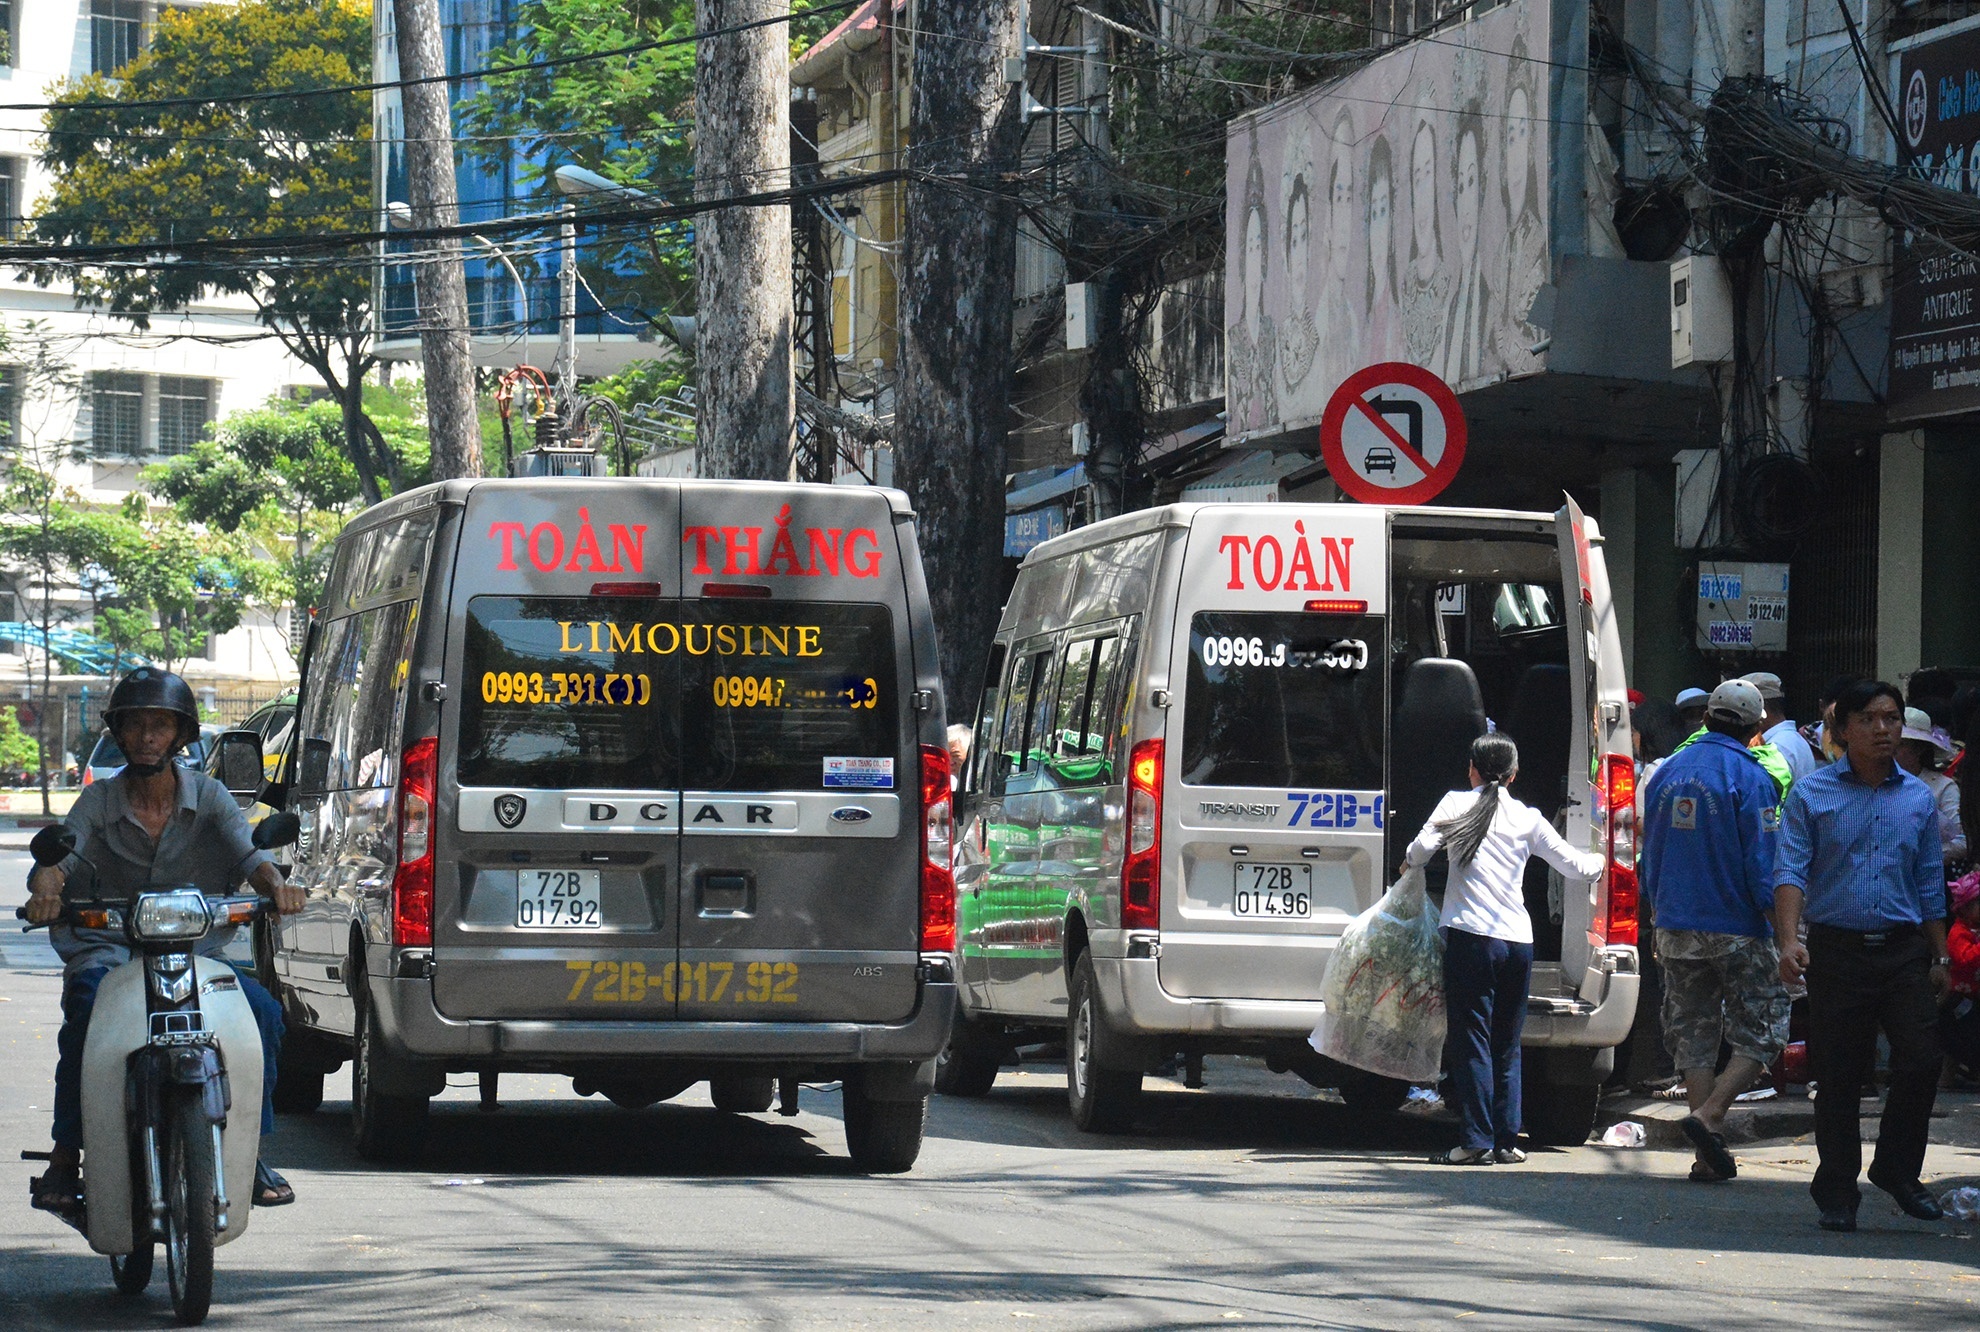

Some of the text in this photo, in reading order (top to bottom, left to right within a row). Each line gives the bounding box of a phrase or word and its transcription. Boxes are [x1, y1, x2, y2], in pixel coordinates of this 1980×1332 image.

[1921, 287, 1974, 323] ANTIQUE
[487, 503, 883, 579] TOÀN THẮNG
[1218, 519, 1355, 592] TOÀN
[558, 622, 824, 657] LIMOUSINE
[1200, 801, 1281, 817] TRANSIT
[536, 871, 582, 898] 72B
[1252, 866, 1293, 890] 72B
[519, 899, 599, 926] 017.92
[1237, 891, 1309, 915] 014.96
[565, 960, 799, 1002] 72B-017.92
[852, 966, 883, 977] ABS
